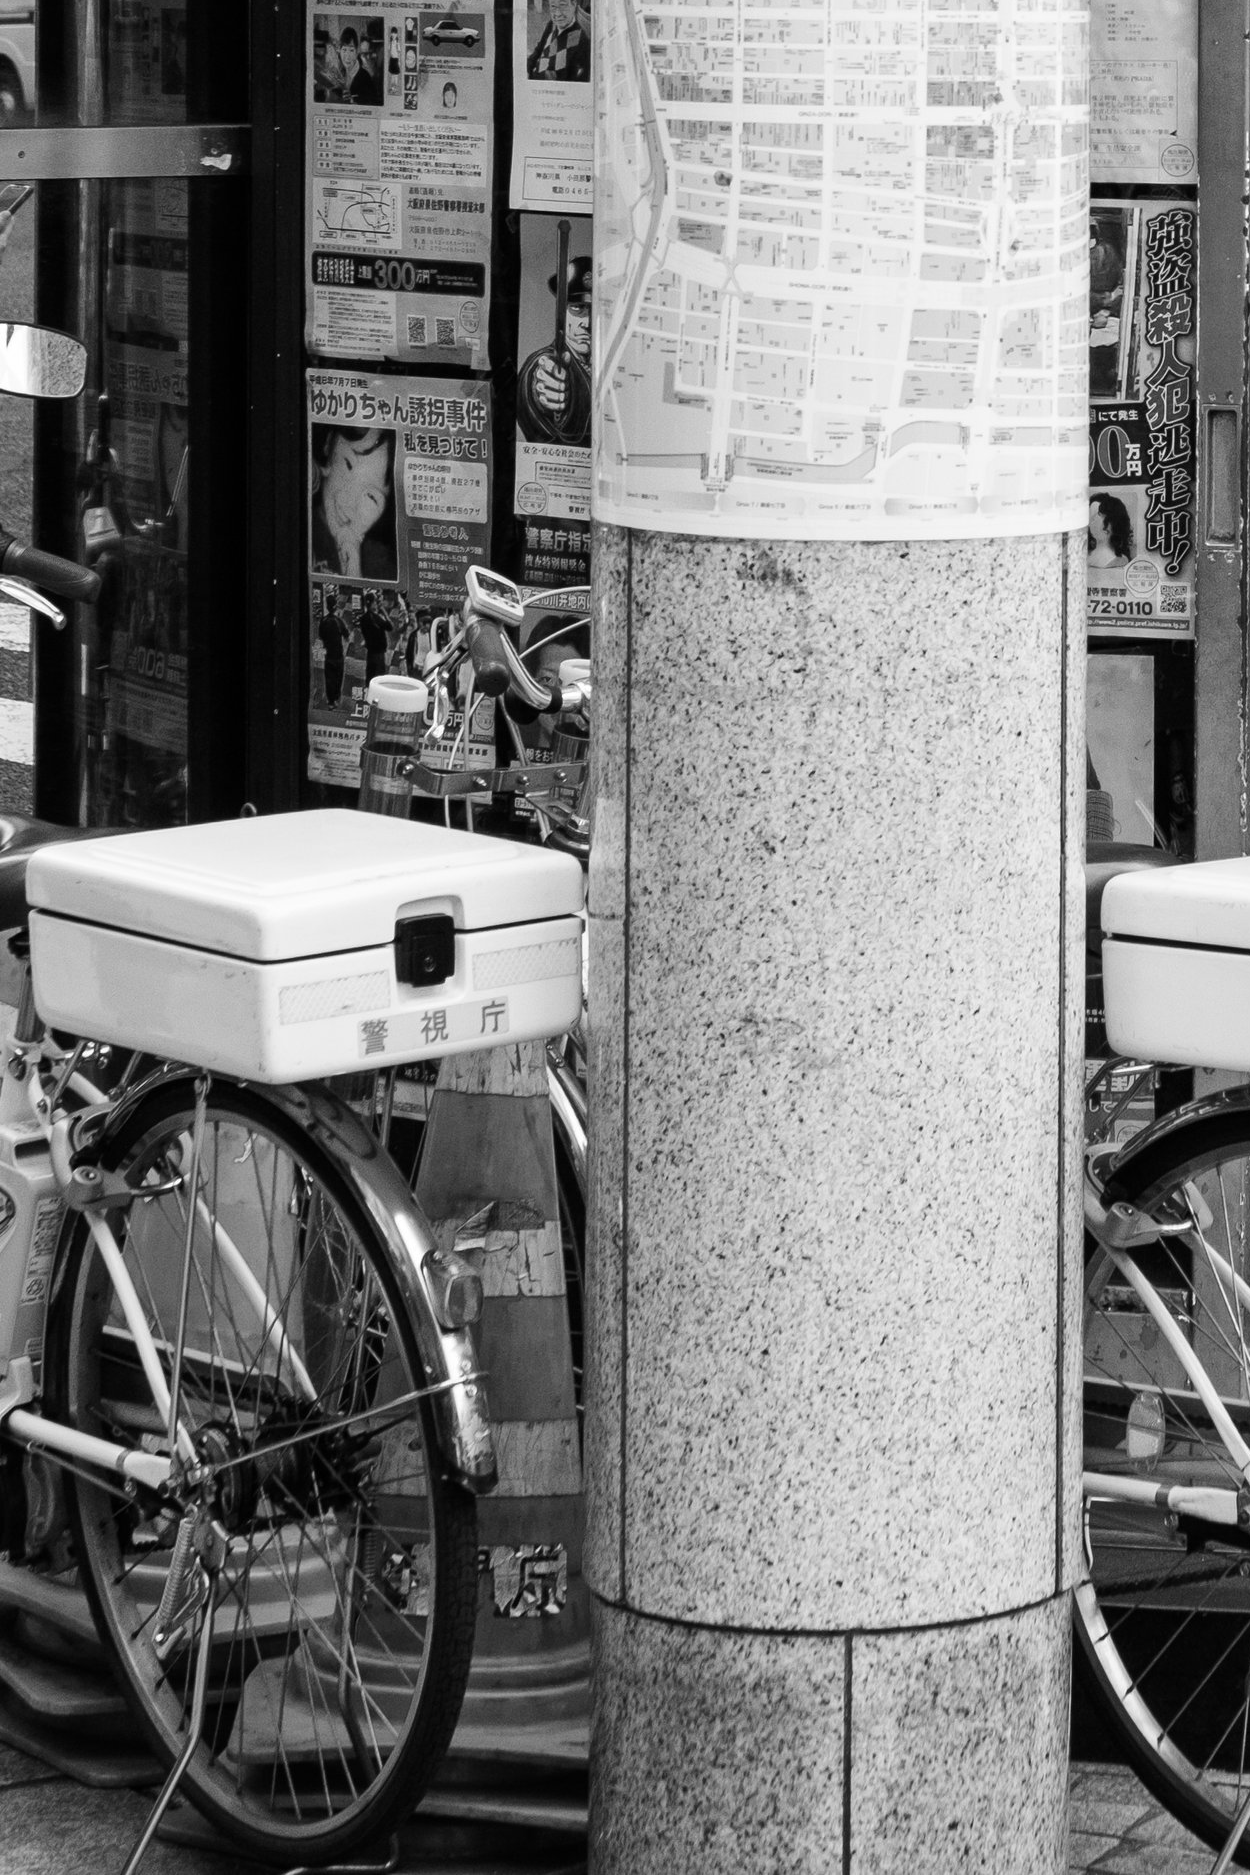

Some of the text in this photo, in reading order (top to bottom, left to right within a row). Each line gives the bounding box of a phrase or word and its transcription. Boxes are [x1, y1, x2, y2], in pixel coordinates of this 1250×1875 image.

[374, 259, 431, 291] 300万円
[311, 389, 487, 433] ゆかりちゃん誘拐事件
[1098, 410, 1140, 423] にて発生
[404, 431, 488, 458] 私を見つけて！
[358, 999, 506, 1056] 警視庁
